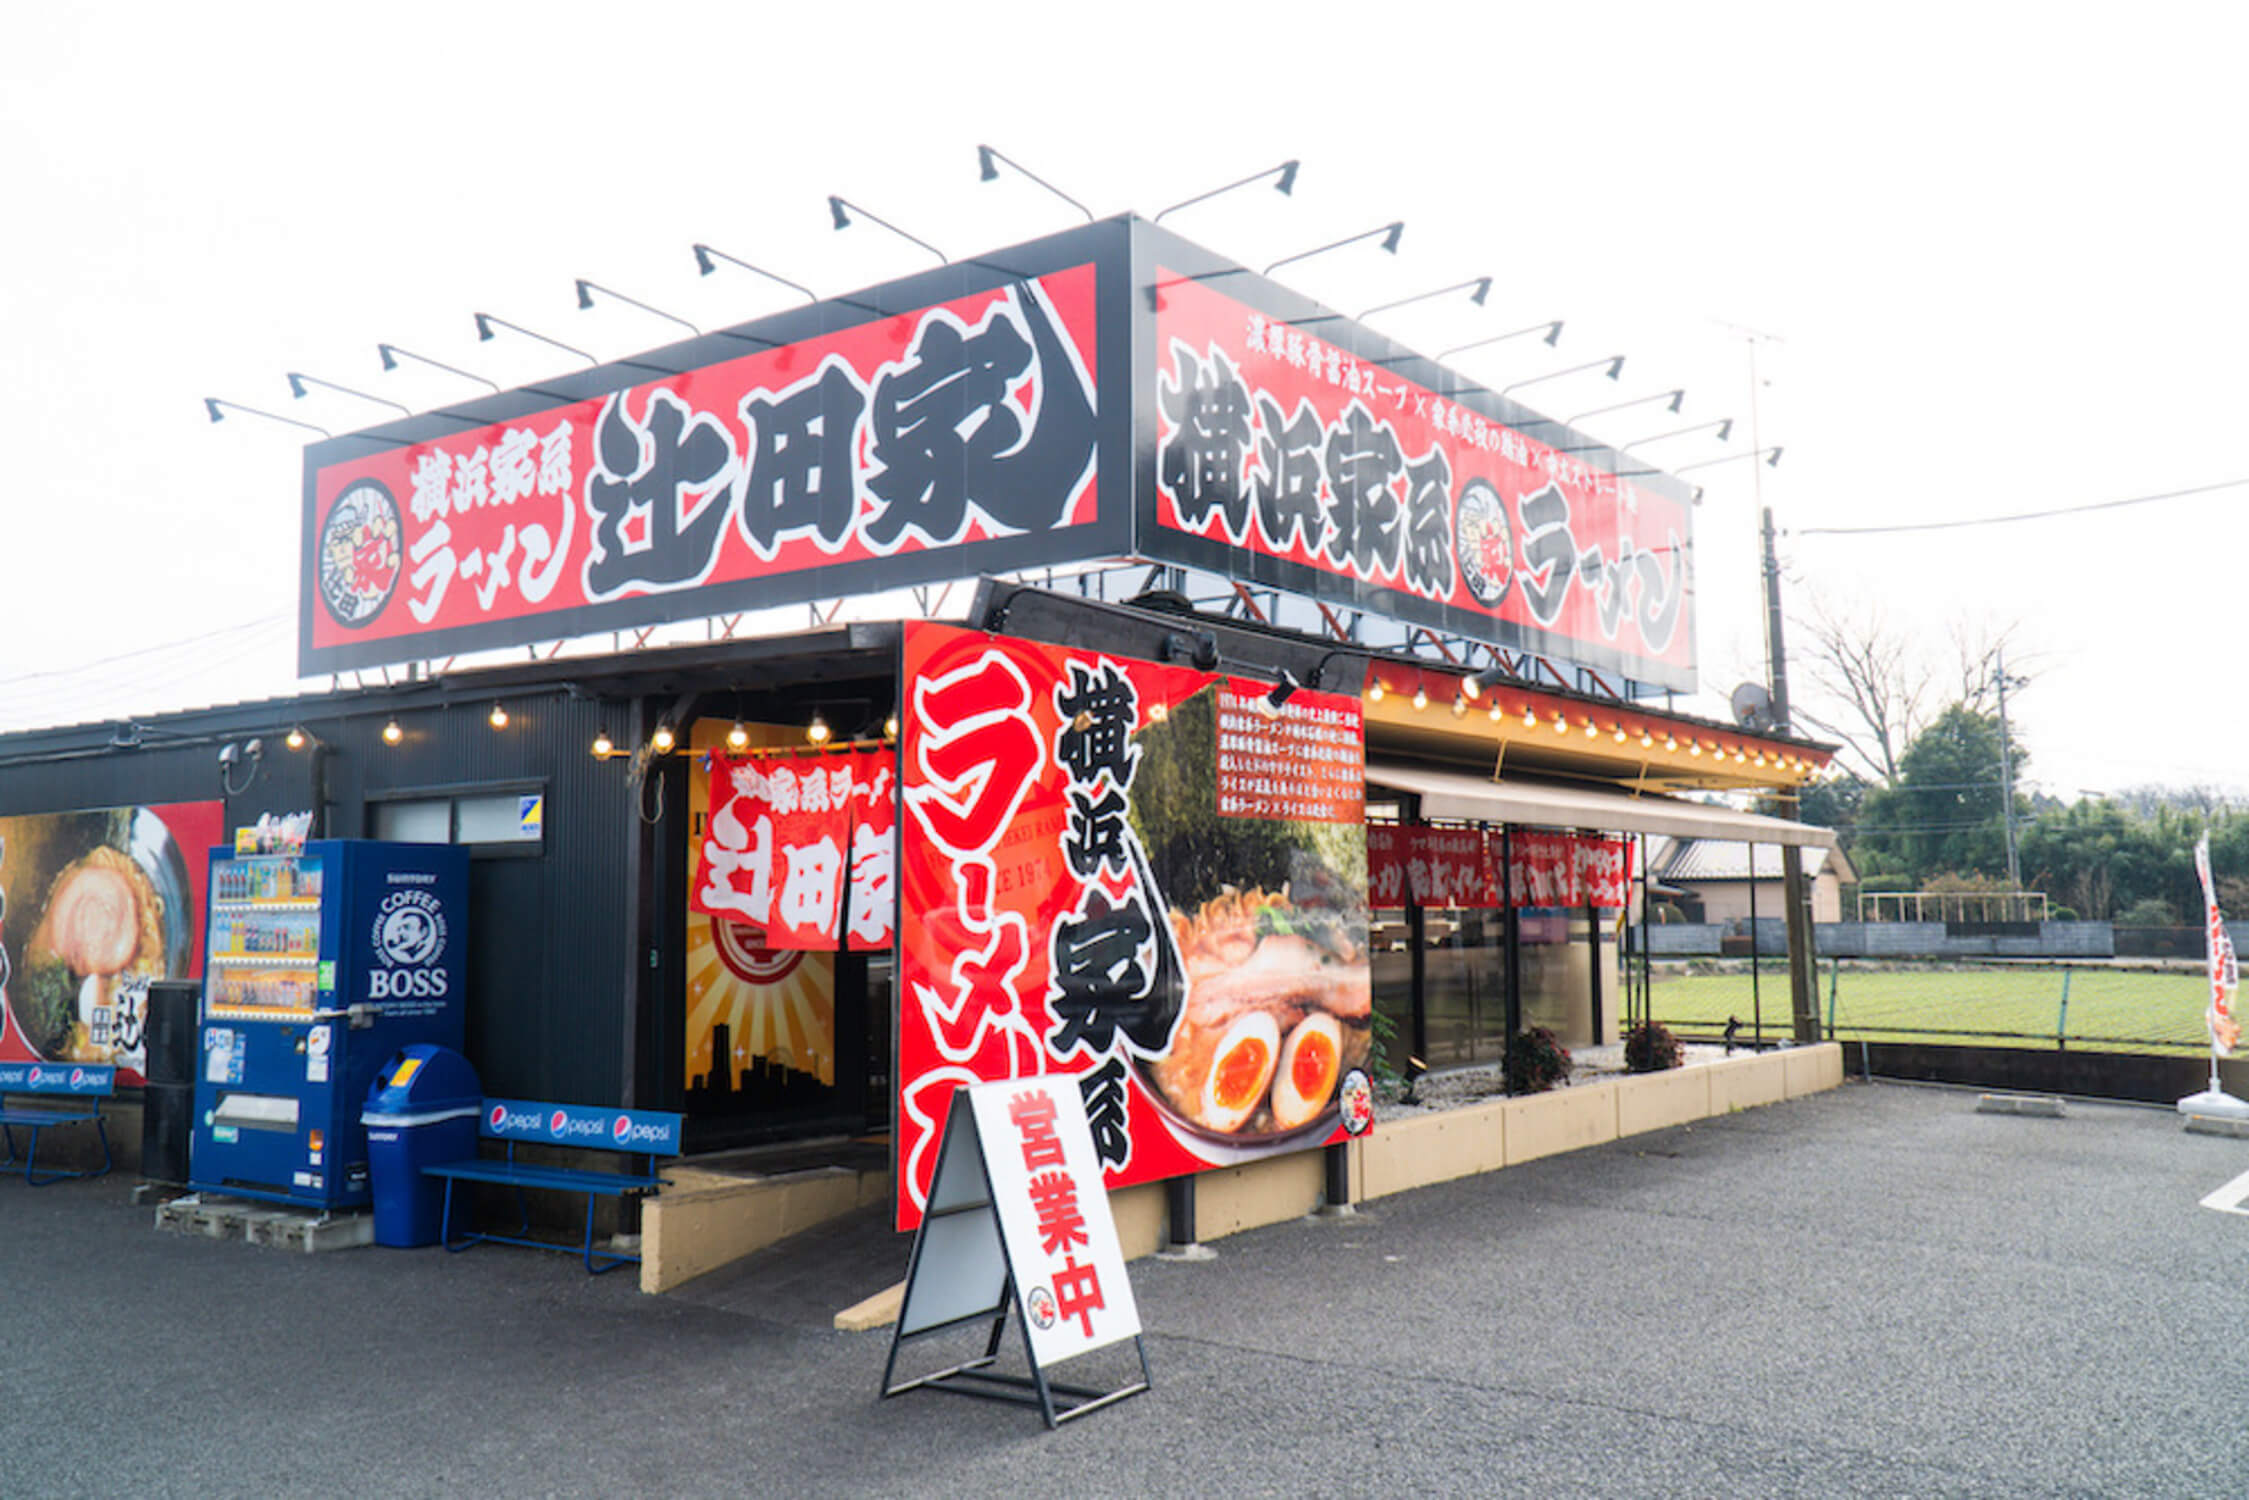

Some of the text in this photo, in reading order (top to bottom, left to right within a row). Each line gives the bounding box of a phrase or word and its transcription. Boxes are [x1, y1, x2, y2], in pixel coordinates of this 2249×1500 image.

[410, 419, 574, 522] 横浜家系
[582, 278, 1097, 603] 辻田家
[1158, 337, 1683, 654] 横浜家系 ラーメン
[408, 493, 576, 623] ラーメン
[381, 890, 442, 914] COFFEE
[368, 968, 448, 998] BOSS
[507, 1113, 670, 1142] pepsi pepsi pepsi
[1007, 1088, 1106, 1338] 営業中
